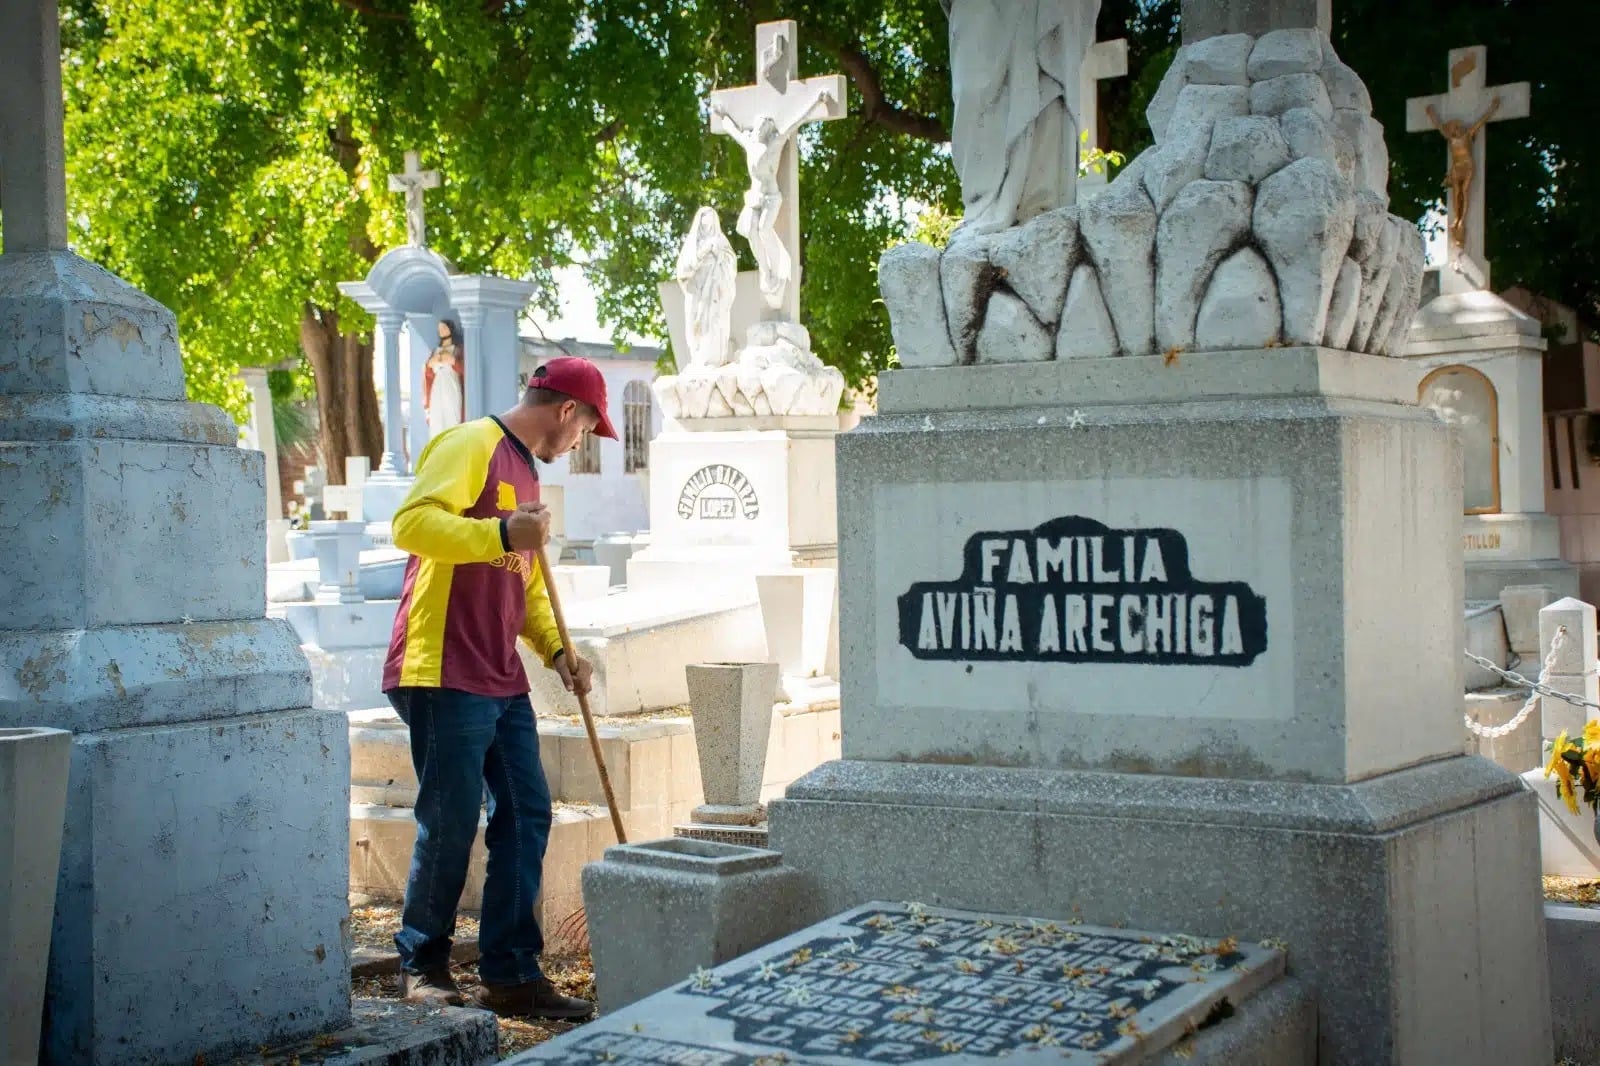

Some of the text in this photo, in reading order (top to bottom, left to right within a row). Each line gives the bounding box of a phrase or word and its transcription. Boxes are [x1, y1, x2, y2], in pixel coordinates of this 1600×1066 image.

[981, 535, 1168, 584] FAMILIA
[917, 586, 1244, 657] AVIÑA ARECHIGA
[920, 919, 1193, 962] CONCEPCIO
[772, 955, 918, 983] EDRO
[726, 1003, 791, 1022] DE
[783, 1011, 876, 1034] SUS
[941, 995, 1013, 1014] DE
